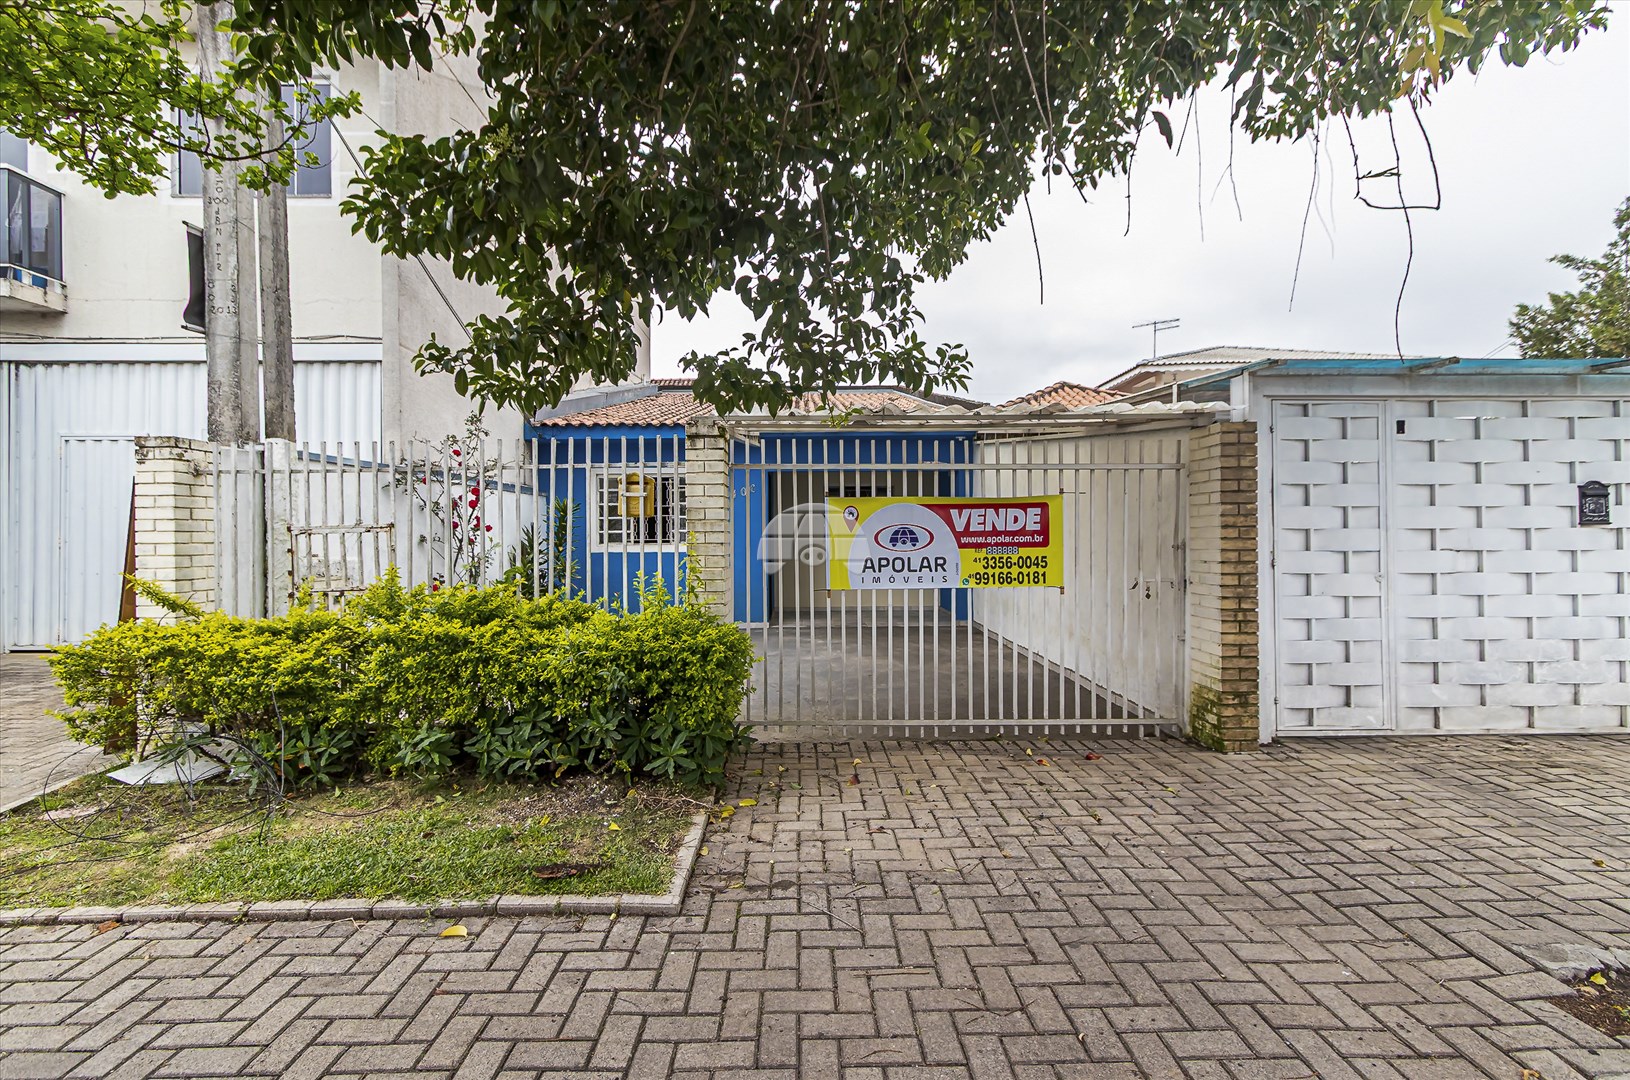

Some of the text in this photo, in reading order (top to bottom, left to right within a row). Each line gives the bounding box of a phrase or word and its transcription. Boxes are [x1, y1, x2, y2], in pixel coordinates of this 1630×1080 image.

[950, 508, 1041, 531] VENDE
[960, 534, 1044, 544] www.apolar.com.br
[862, 556, 947, 573] APOLAR
[861, 575, 948, 584] IMÓVEIS
